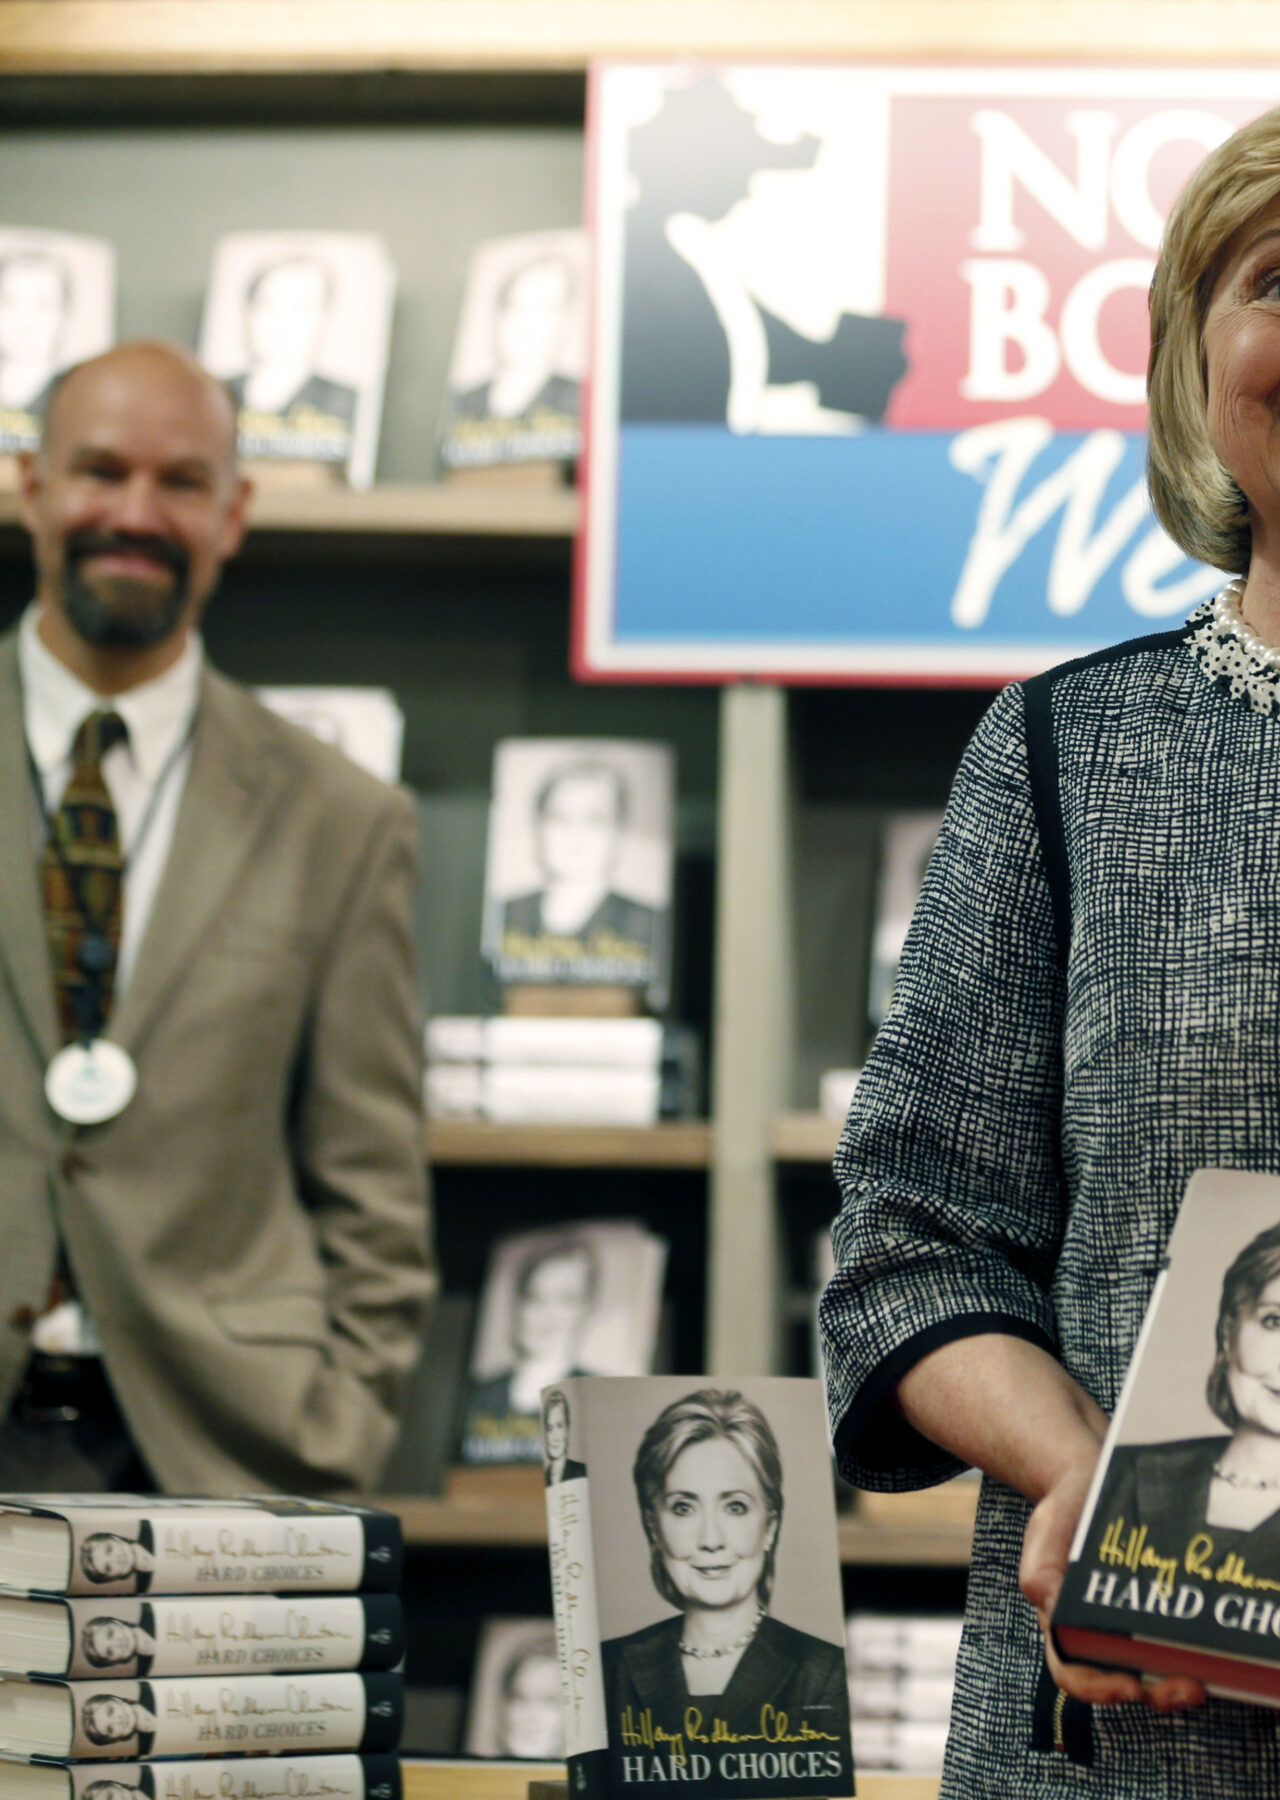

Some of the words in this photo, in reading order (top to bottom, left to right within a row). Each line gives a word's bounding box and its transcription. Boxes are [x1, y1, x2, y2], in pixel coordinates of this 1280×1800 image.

[195, 1566, 247, 1582] HARD
[251, 1564, 324, 1581] CHOICES
[1099, 1517, 1178, 1599] Hillary
[1084, 1569, 1205, 1620] HARD
[196, 1649, 247, 1665] HARD
[251, 1647, 324, 1664] CHOICES
[197, 1724, 248, 1741] HARD
[253, 1720, 326, 1739] CHOICES
[621, 1705, 687, 1767] Hillary
[760, 1703, 841, 1743] Clinton
[622, 1754, 711, 1783] HARD
[719, 1751, 843, 1780] CHOICES
